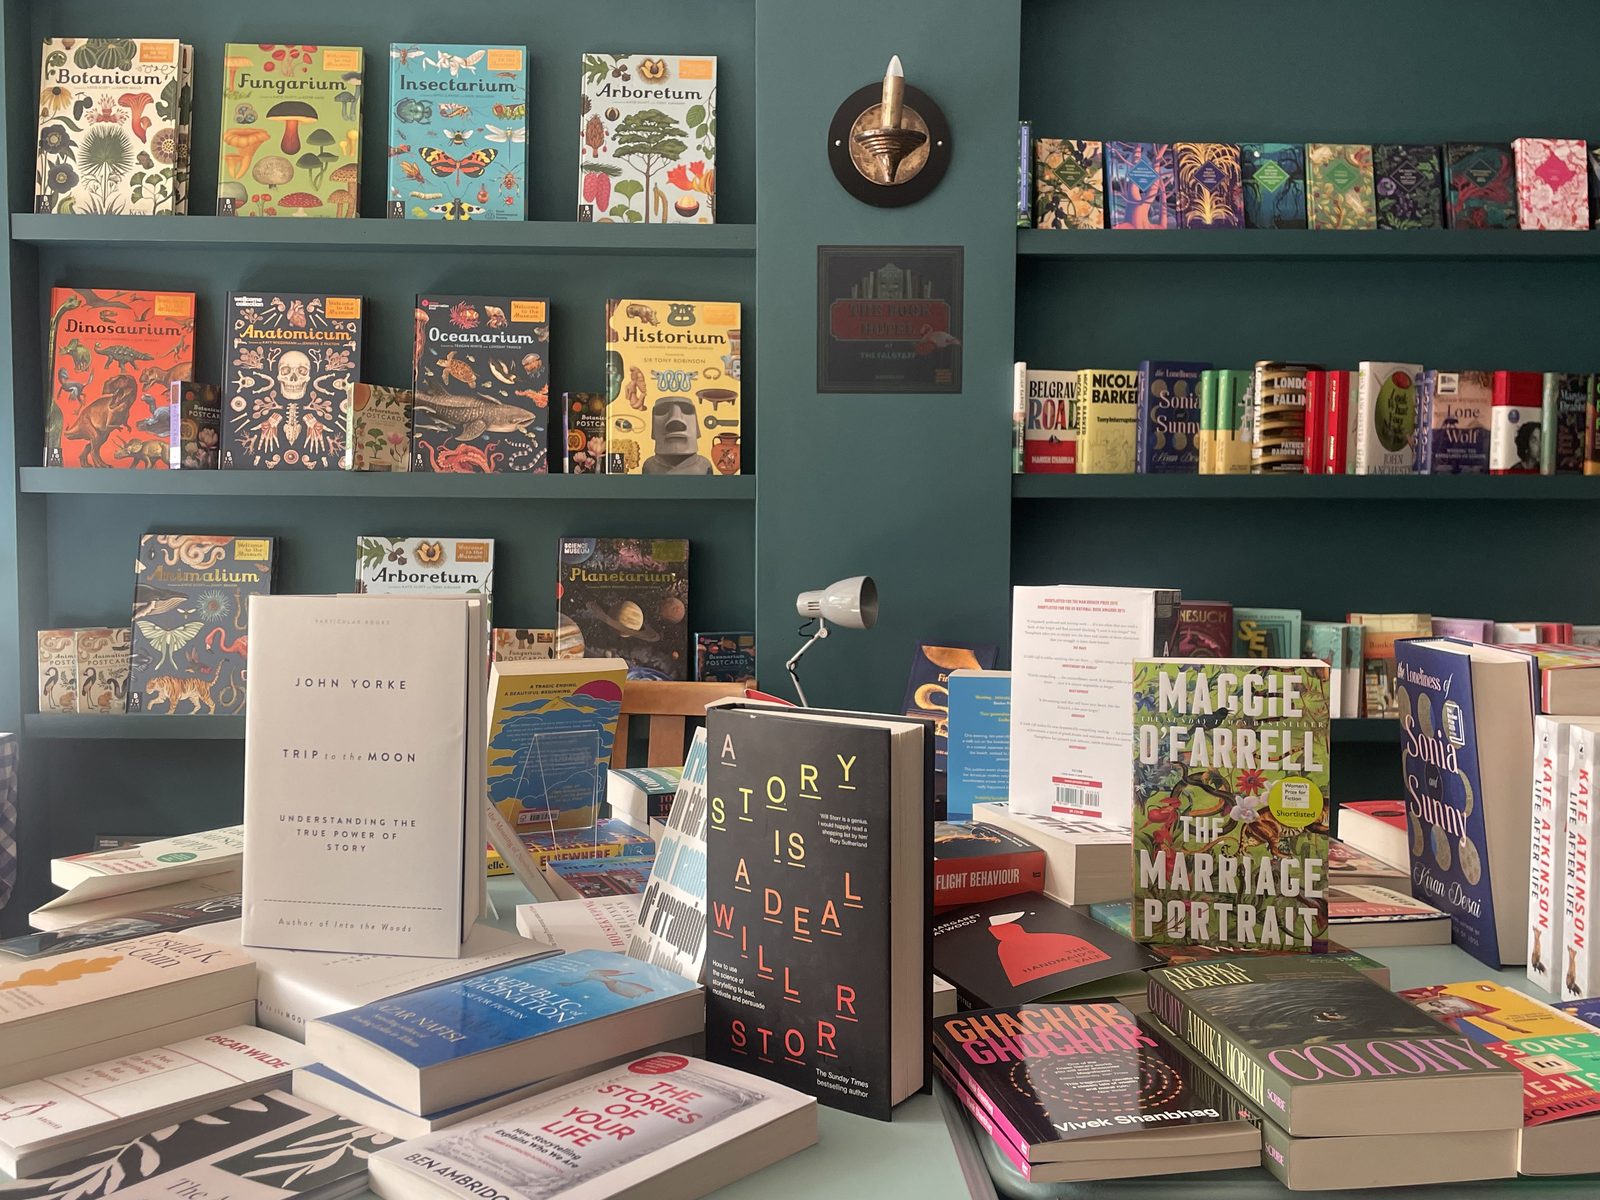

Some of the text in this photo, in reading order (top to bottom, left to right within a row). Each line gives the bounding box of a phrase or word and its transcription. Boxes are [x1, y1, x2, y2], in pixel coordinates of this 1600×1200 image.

[56, 68, 162, 86] Botanicum
[238, 73, 348, 95] Fungarium
[399, 74, 517, 93] Insectarium
[595, 82, 703, 101] Arboretum
[64, 318, 182, 337] Dinosaurium
[240, 324, 352, 341] Anatomicum
[429, 327, 534, 344] Oceanarium
[623, 326, 727, 345] Historium
[1029, 381, 1078, 398] BELGRAV
[1157, 389, 1201, 410] Sonia
[1027, 399, 1078, 430] ROAD
[1447, 403, 1480, 419] Lone
[1446, 427, 1480, 444] Wolf
[1383, 453, 1404, 465] JOHN
[147, 565, 260, 584] Animalium
[371, 567, 479, 584] Arboretum
[569, 567, 676, 583] Planetarium
[295, 678, 407, 690] JOHN YORKE
[1405, 664, 1442, 692] Loneliness
[1443, 672, 1454, 699] of
[1158, 671, 1303, 718] MAGGIE
[1141, 715, 1160, 723] THE
[1166, 716, 1208, 725] SUNDAY
[1253, 719, 1325, 728] BESTSELLER
[721, 733, 736, 760] A
[1139, 724, 1323, 772] O'FARRELL
[1404, 714, 1459, 775] Sonia
[282, 749, 416, 763] TRIP to the MOON
[279, 815, 417, 828] UNDERSTANDING THE
[1276, 809, 1316, 818] Shortlisted
[1408, 774, 1468, 848] Sunny
[296, 829, 398, 840] TRUE POWER OF
[834, 823, 851, 831] happily
[1180, 815, 1224, 845] THE
[327, 843, 367, 852] STORY
[774, 829, 805, 861] IS
[829, 837, 868, 848] Rory Sutherland
[1531, 779, 1542, 900] LIFE AFTER LIFE
[1538, 757, 1553, 929] KATE ATKINSON
[1565, 791, 1578, 918] LIFE AFTER LIFE
[1574, 768, 1589, 949] KATE ATKINSON
[735, 857, 750, 885] A
[936, 868, 1020, 891] FLIGHT BEHAVIOUR
[1140, 849, 1323, 899] MARRIAGE
[1413, 861, 1482, 919] Kiran Desai
[278, 917, 412, 933] Author of Into the Woods
[933, 918, 977, 937] ATWOOD
[1144, 898, 1318, 947] PORTRAIT
[1067, 945, 1089, 955] THE
[1073, 954, 1103, 964] TALE
[712, 959, 722, 968] How
[729, 966, 738, 974] use
[1022, 949, 1096, 974] HANDMAID'S
[1162, 962, 1249, 982] ANNIKA
[712, 969, 720, 977] the
[720, 972, 738, 983] science
[712, 979, 737, 994] storytelling
[1169, 972, 1254, 991] NORLIN
[487, 975, 582, 1012] REPUBLIC
[712, 988, 765, 1010] motivate and persuade
[944, 1002, 1133, 1043] GHACHAR
[204, 1034, 292, 1070] OSCAR WILDE
[961, 1023, 1159, 1066] GHOCHAR
[1266, 1037, 1502, 1082] COLONY
[1532, 1058, 1563, 1070] In
[816, 1068, 869, 1089] The Sunday Times
[816, 1078, 869, 1099] bestselling author
[648, 1081, 704, 1105] THE
[597, 1084, 704, 1125] STORIES
[604, 1103, 648, 1120] OF
[562, 1106, 636, 1141] YOUR
[1052, 1106, 1220, 1133] Vivek Shanbhag
[512, 1127, 531, 1138] How
[531, 1135, 582, 1161] Storytelling
[541, 1120, 602, 1148] LIFE
[495, 1129, 579, 1169] Explains Who We Are
[403, 1152, 441, 1170] BEN
